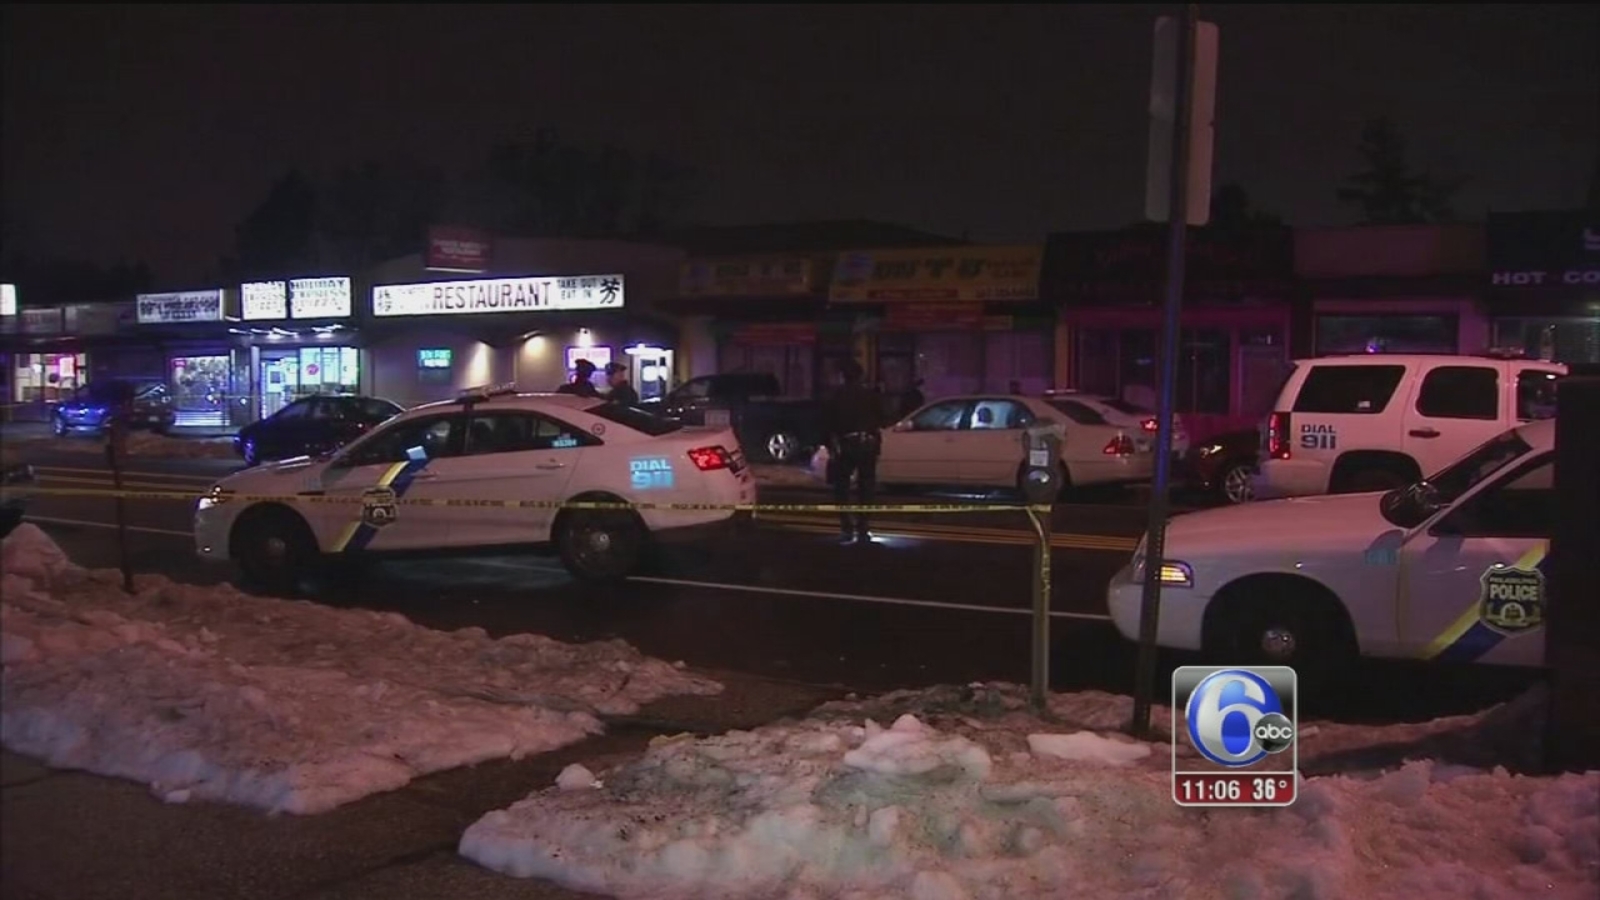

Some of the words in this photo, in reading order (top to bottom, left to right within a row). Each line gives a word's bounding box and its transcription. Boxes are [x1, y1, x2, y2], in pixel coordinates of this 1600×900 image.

[556, 278, 577, 289] TAKE
[1493, 271, 1547, 285] HOT
[432, 282, 551, 309] RESTAURANT
[560, 289, 576, 300] EAT
[600, 278, 621, 305] 芳
[1301, 424, 1337, 434] DIAL
[1300, 434, 1336, 449] 911
[630, 458, 672, 471] DIAL
[630, 471, 674, 489] 911
[1490, 584, 1539, 601] POLICE
